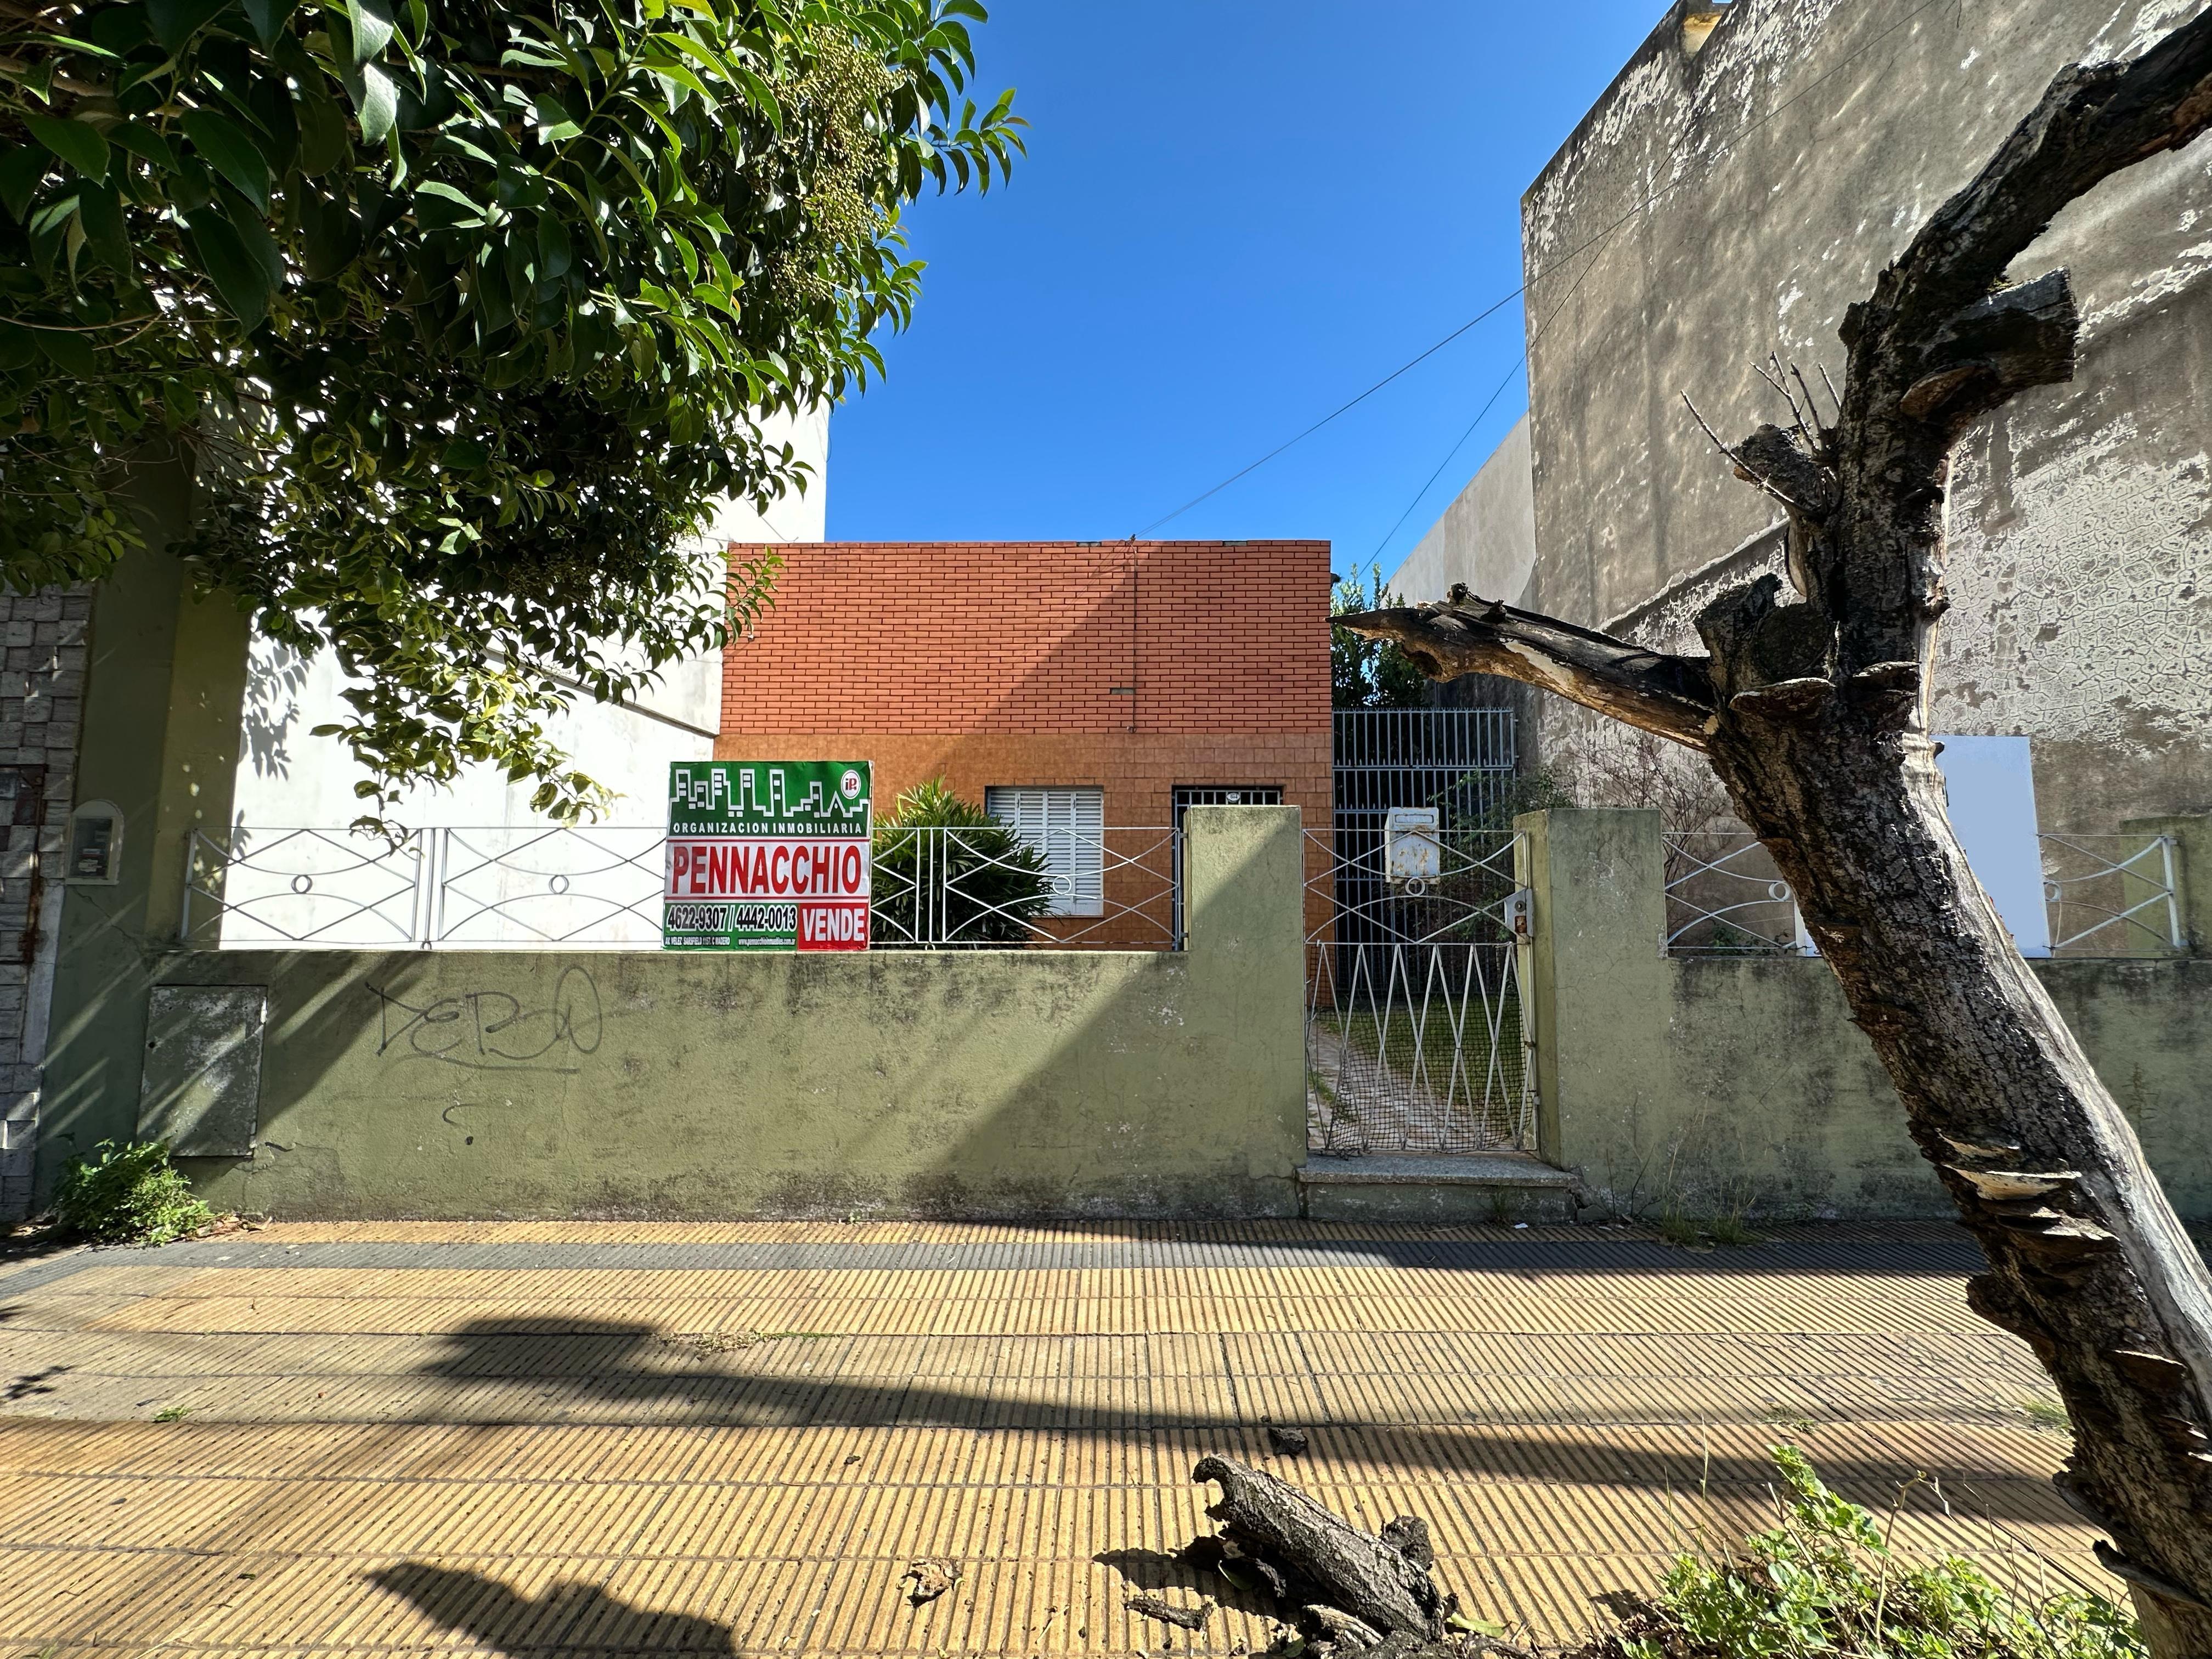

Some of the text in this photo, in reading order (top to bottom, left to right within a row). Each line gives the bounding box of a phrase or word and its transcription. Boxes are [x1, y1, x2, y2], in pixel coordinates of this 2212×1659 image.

[673, 822, 862, 834] ORGANIZACION INMOBILIARIA
[672, 845, 862, 895] PENNACCHIO
[667, 905, 727, 931] 4622-9307
[736, 905, 797, 932] 4442-0013
[803, 908, 866, 942] VENDE
[671, 936, 682, 945] VELEZ
[683, 936, 702, 945] SARSFIELD
